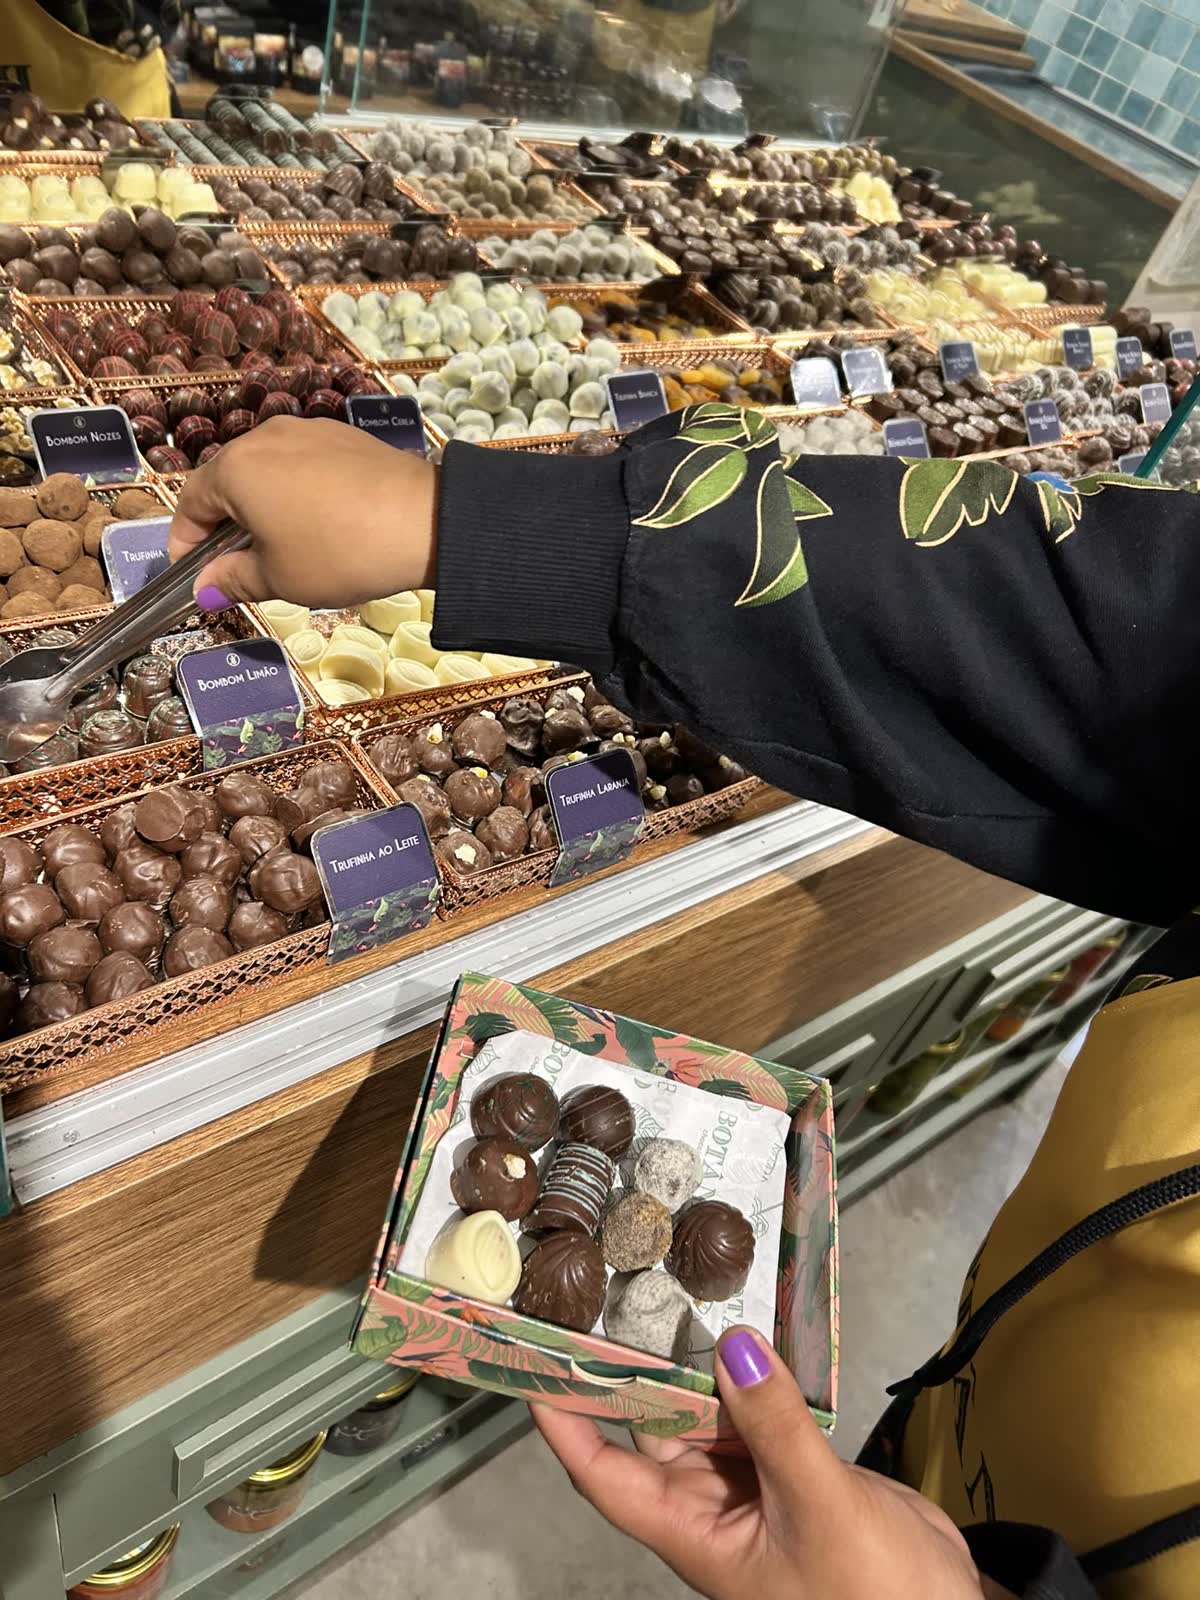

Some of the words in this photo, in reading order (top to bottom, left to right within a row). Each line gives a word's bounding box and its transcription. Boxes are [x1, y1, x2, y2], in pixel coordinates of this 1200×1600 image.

[47, 432, 88, 447] BOMBOM
[90, 430, 122, 444] NOZES
[122, 550, 165, 562] TRUFINHA
[198, 676, 245, 692] BOMBOM
[246, 665, 279, 682] LIMÃO
[559, 788, 596, 807] TRUFINHA
[596, 777, 630, 796] LARANJA
[329, 850, 376, 874] TRUFINHA
[378, 845, 393, 858] AO
[394, 834, 420, 851] LEITE
